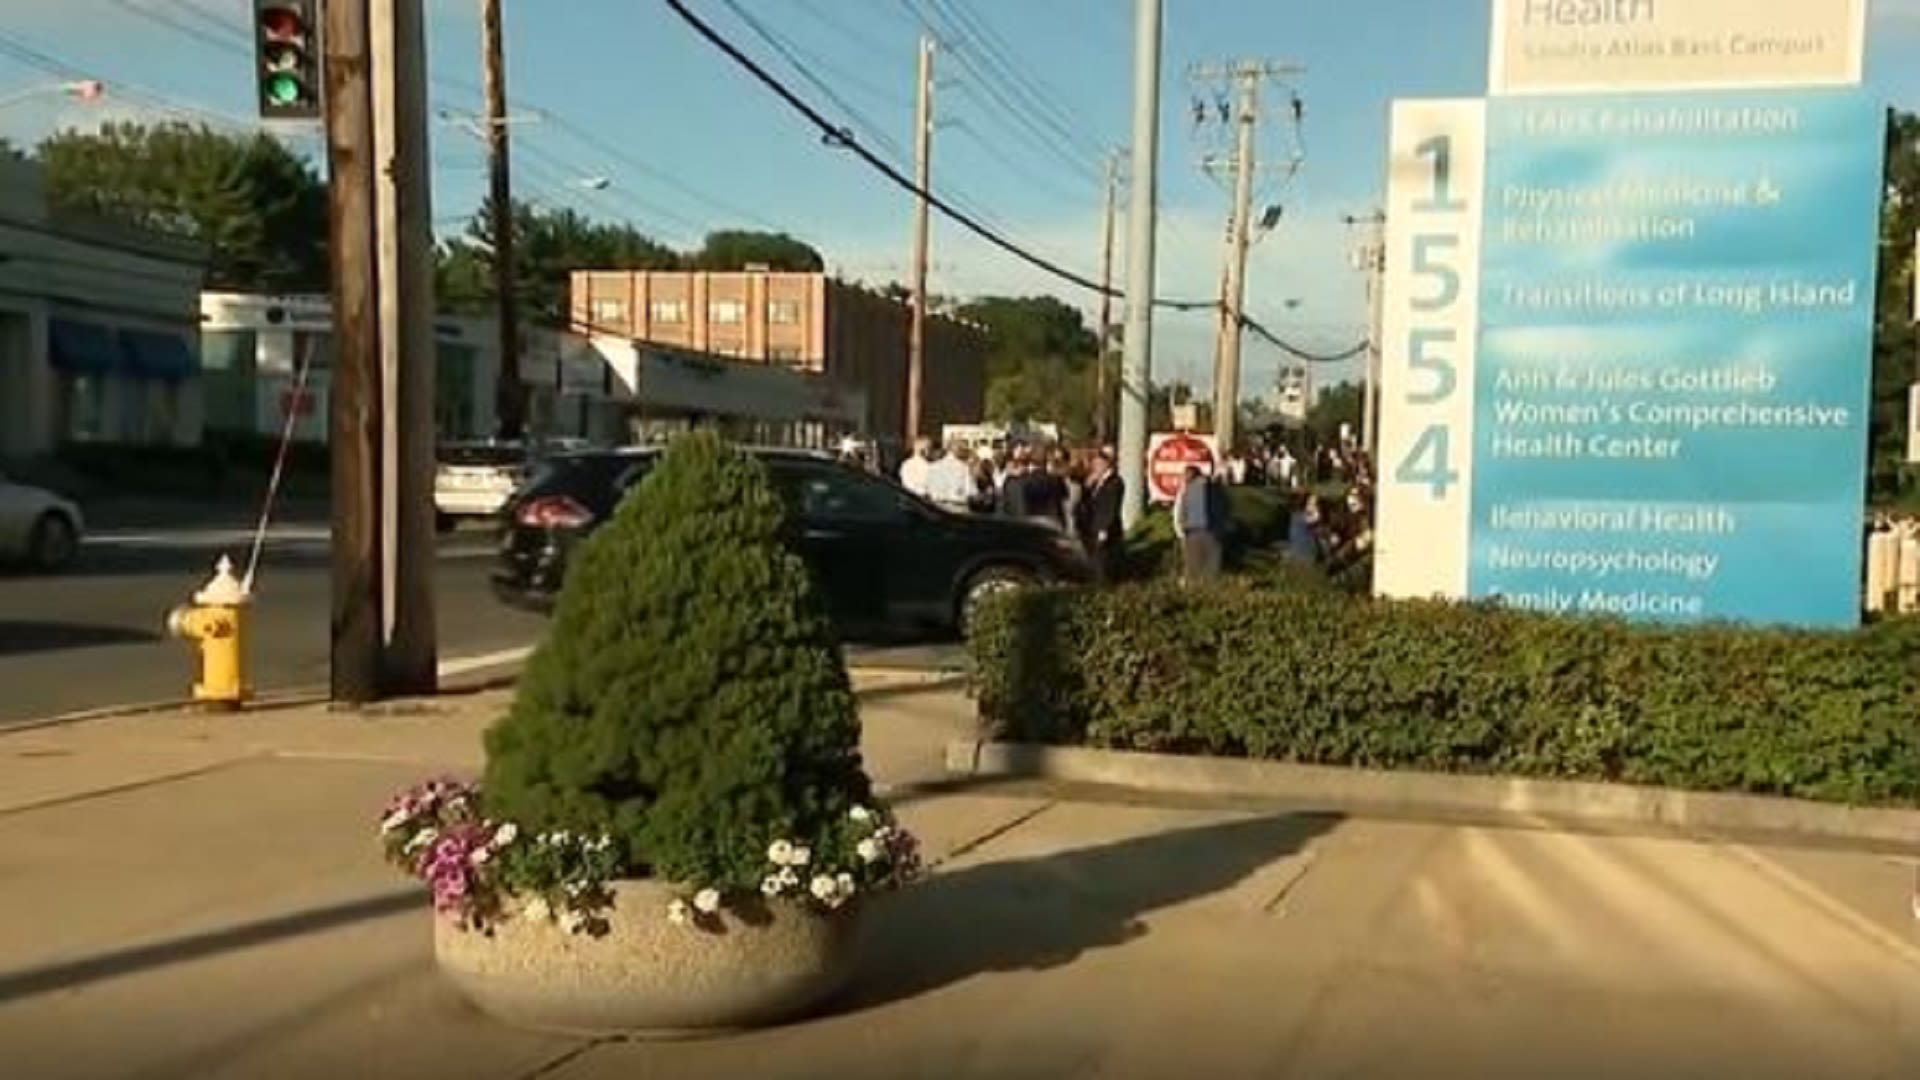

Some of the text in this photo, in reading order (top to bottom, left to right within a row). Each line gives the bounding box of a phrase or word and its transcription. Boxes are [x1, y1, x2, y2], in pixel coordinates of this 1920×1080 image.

[1523, 0, 1655, 25] Health
[1601, 106, 1799, 134] Rehabilitation
[1756, 179, 1781, 206] &
[1502, 279, 1856, 311] Transitions of Long Island
[1494, 364, 1776, 393] Ann & Jules Gottlieb
[1628, 399, 1849, 430] Comprehensive
[1492, 432, 1682, 458] Health Center
[1490, 504, 1736, 533] Behavioral Health
[1487, 545, 1719, 578] Neuropsychology
[1578, 588, 1703, 614] Medicine
